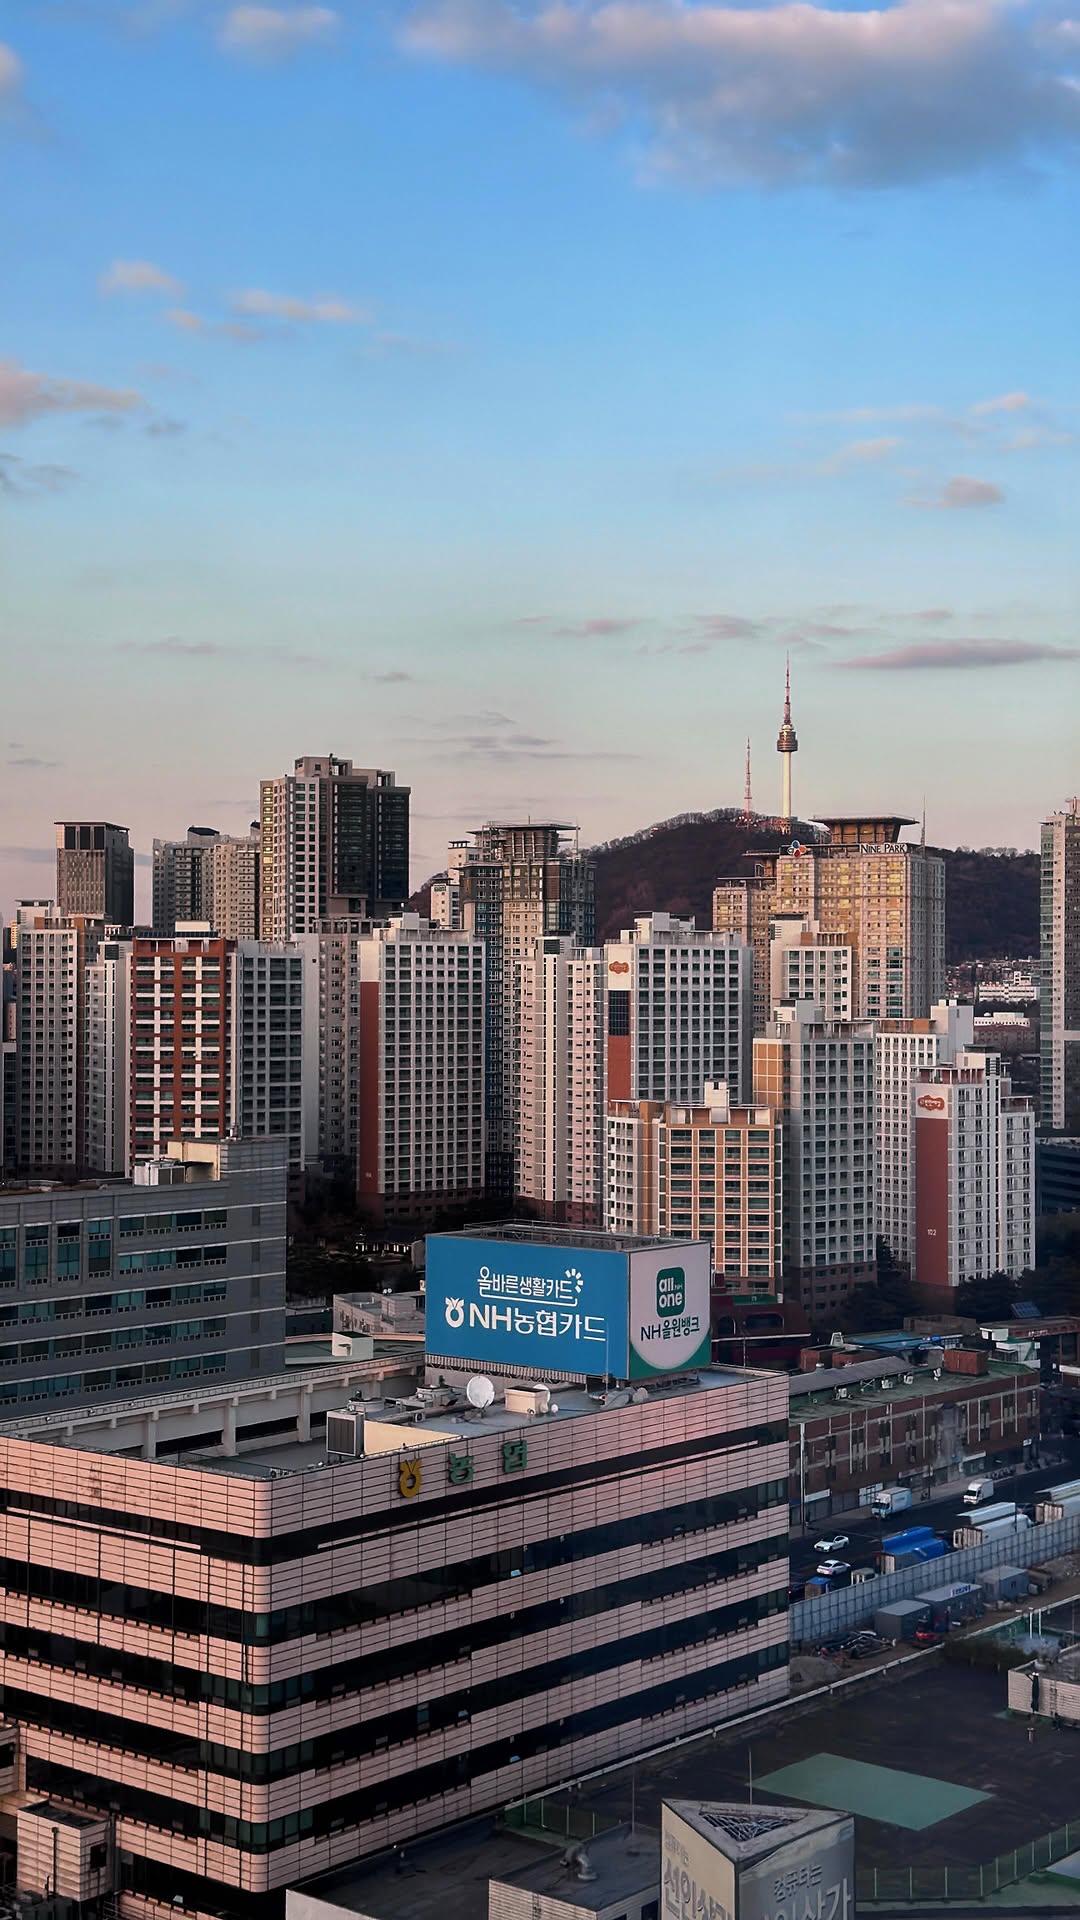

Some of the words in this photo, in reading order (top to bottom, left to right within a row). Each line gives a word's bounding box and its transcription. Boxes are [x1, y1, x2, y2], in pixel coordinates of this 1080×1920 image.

[861, 844, 881, 853] NINE
[884, 843, 905, 853] PARK
[658, 1293, 683, 1309] one
[469, 1304, 606, 1342] NH농협카드
[640, 1315, 701, 1342] NH올원뱅크
